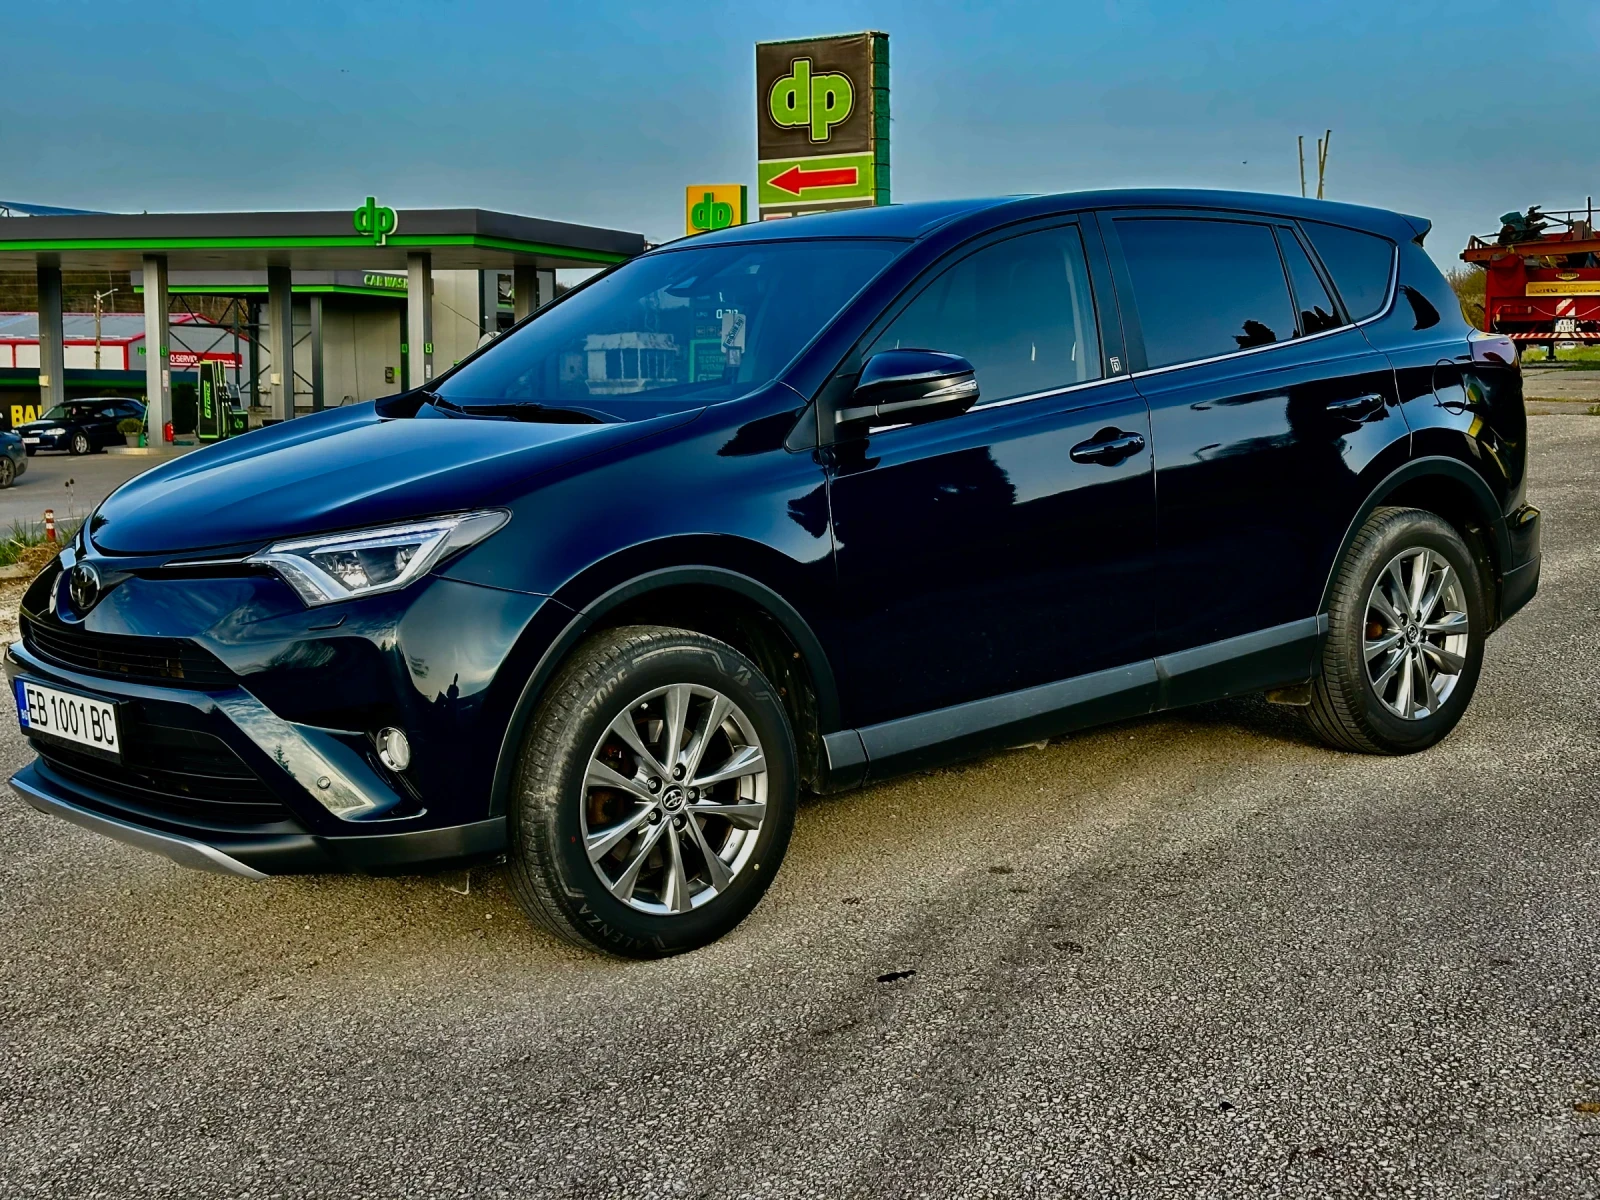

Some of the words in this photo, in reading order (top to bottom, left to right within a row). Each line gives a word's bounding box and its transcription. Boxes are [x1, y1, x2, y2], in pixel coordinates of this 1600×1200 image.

[769, 58, 853, 141] dp
[353, 197, 397, 245] dp
[363, 274, 383, 286] CAR
[27, 689, 48, 727] EB
[51, 695, 88, 739] 1001
[90, 706, 114, 745] BC
[579, 903, 648, 951] ALENZA
